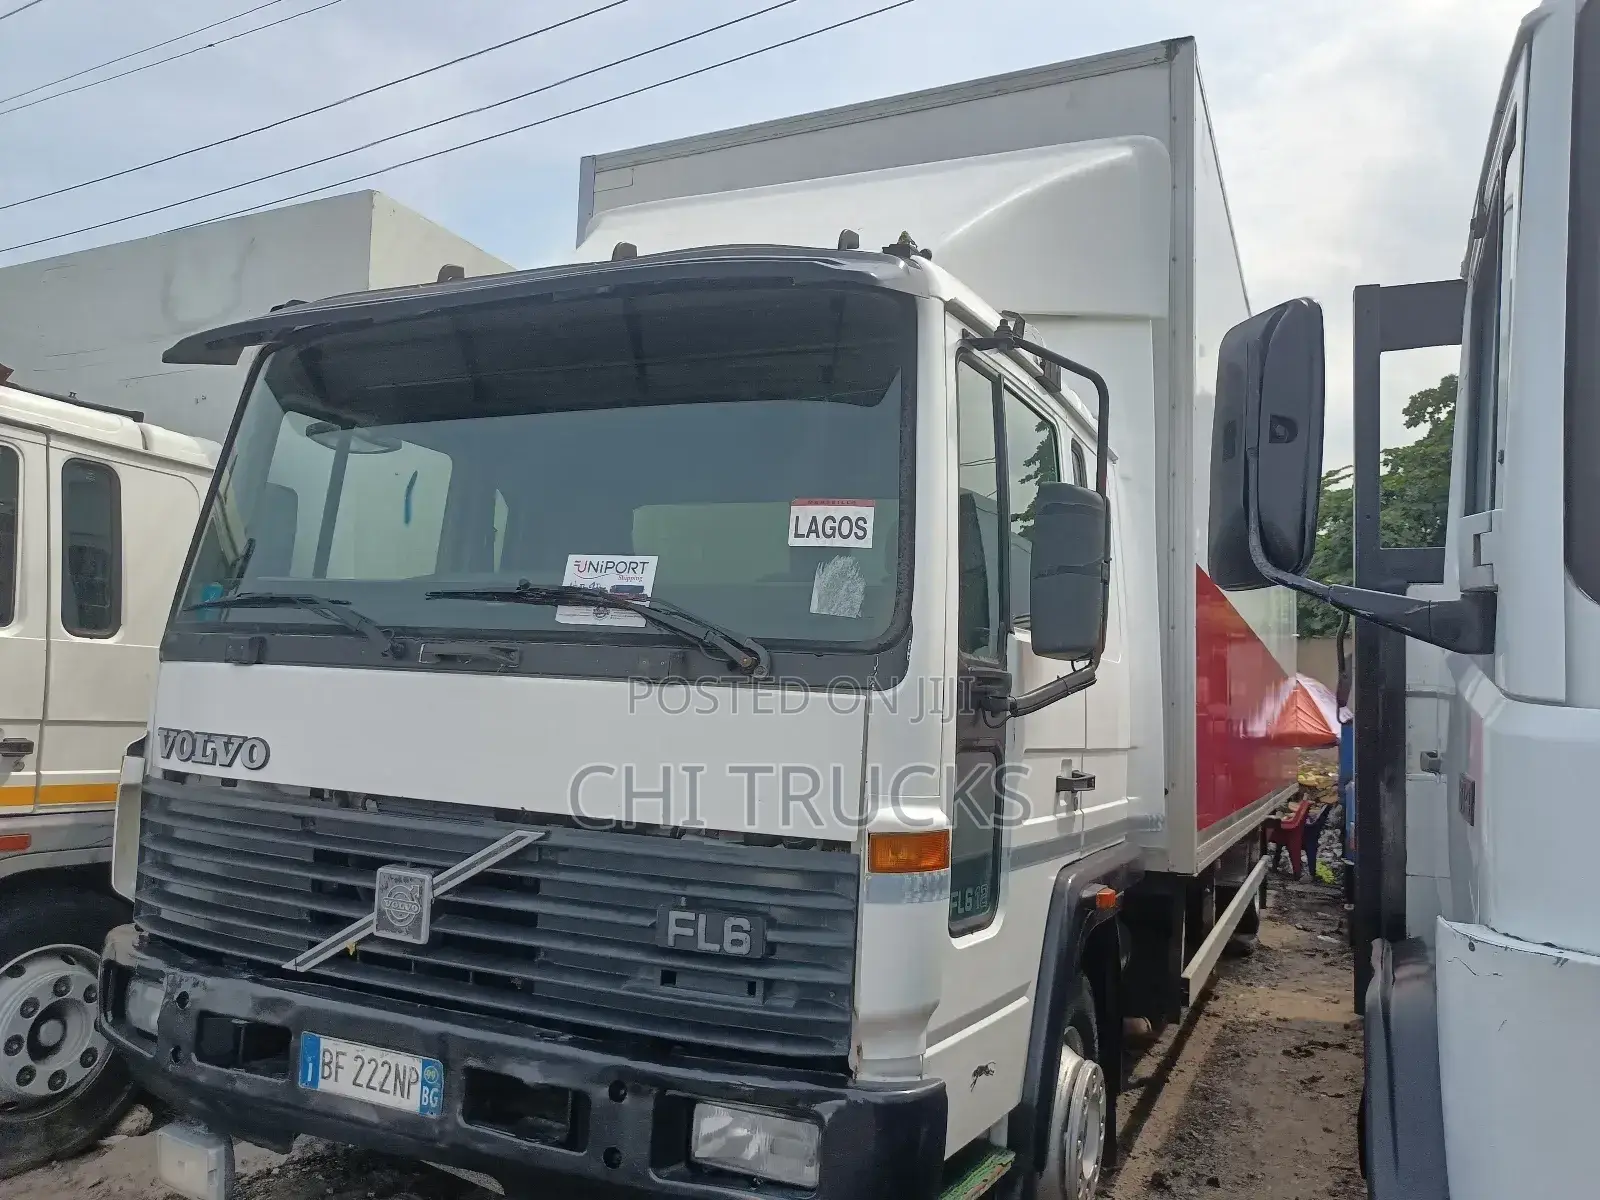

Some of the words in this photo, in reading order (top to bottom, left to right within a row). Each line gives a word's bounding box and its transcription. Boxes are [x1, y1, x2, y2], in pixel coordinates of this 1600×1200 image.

[793, 515, 868, 541] LAGOS
[158, 726, 270, 771] VOLVO
[383, 898, 420, 913] VOLVO
[667, 910, 751, 955] FL6
[321, 1048, 347, 1082] BF
[352, 1055, 420, 1100] 222NP
[421, 1085, 439, 1108] BG
